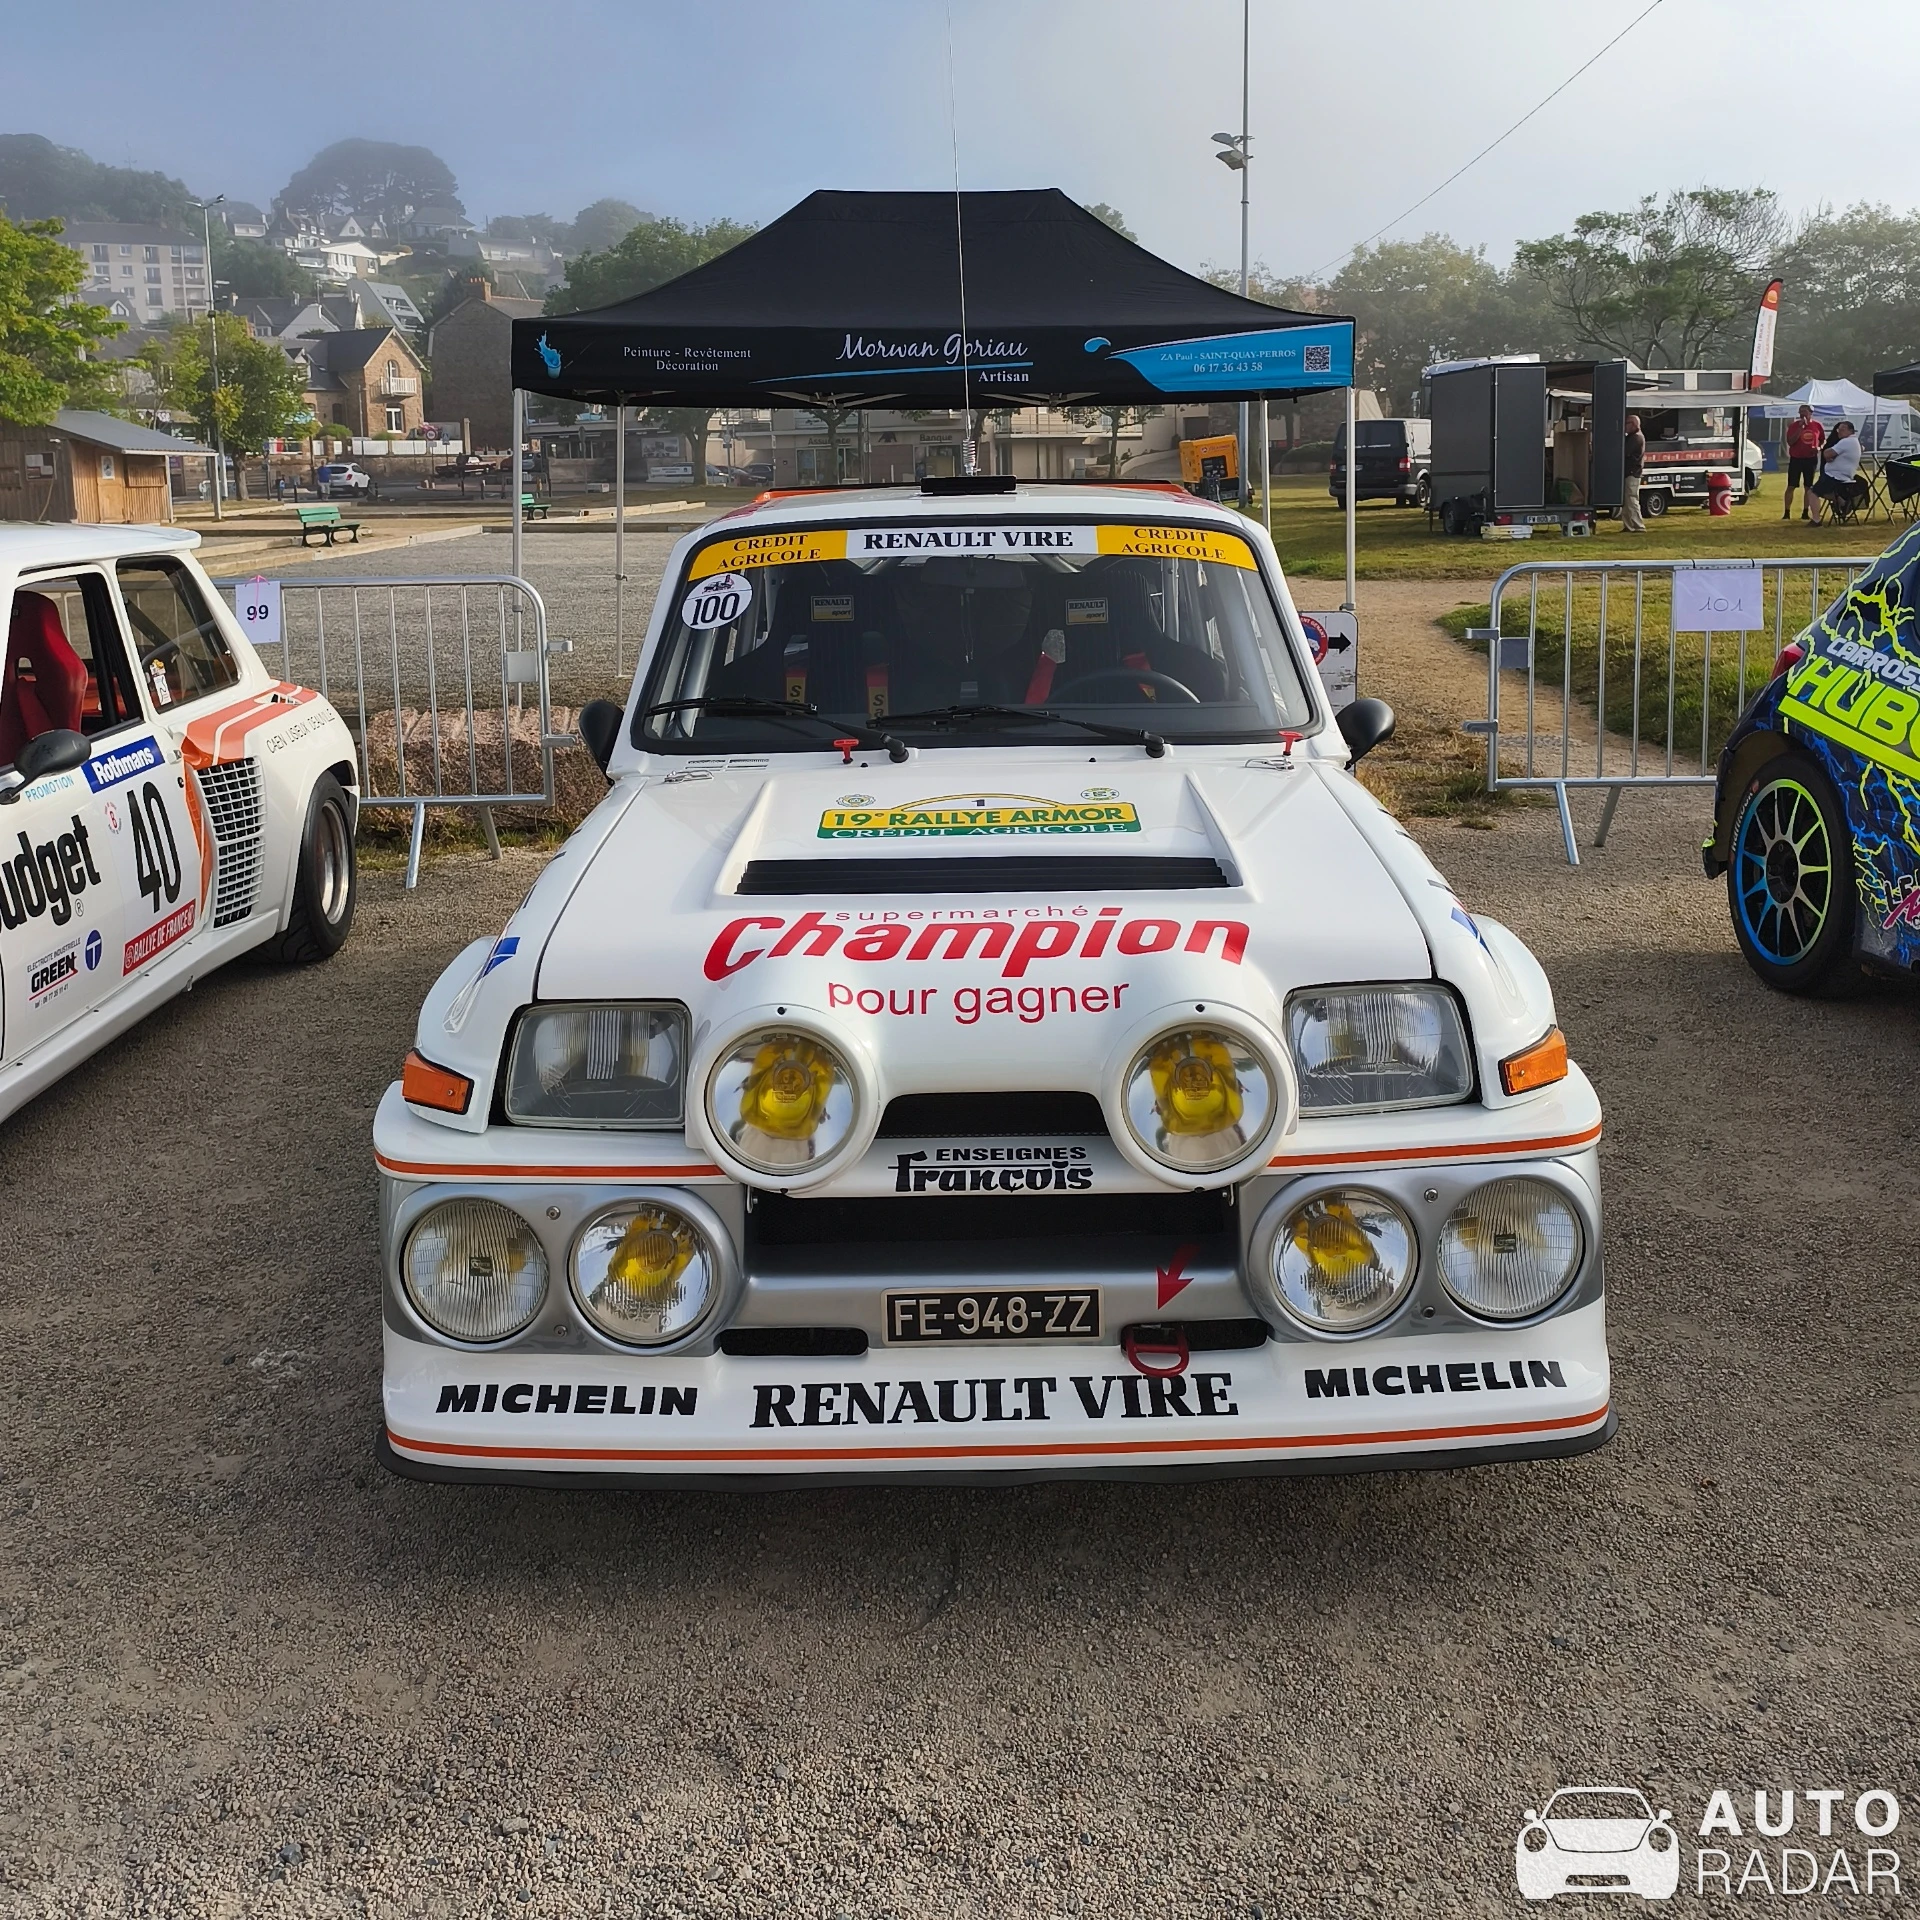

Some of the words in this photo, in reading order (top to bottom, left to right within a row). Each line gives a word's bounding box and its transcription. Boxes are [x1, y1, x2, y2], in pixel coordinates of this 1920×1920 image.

[623, 346, 671, 357] Peinture
[684, 347, 751, 358] Revêtement
[836, 334, 939, 360] Morwan
[943, 333, 1029, 365] Goriau
[1160, 353, 1173, 361] ZA
[1175, 352, 1193, 361] Paul
[1199, 349, 1297, 361] SAINT-QUAY-PERROS
[656, 360, 719, 371] Décoration
[1193, 363, 1206, 373] 06
[1208, 363, 1219, 373] 17
[1221, 363, 1234, 373] 36
[1236, 363, 1248, 372] 43
[1250, 362, 1263, 372] 58
[978, 371, 1030, 382] Artisan
[919, 433, 953, 442] Banque
[733, 534, 809, 552] CREDIT
[863, 531, 997, 549] RENAULT
[1001, 531, 1074, 547] VIRE
[1133, 528, 1209, 543] CREDIT
[717, 549, 821, 570] AGRICOLE
[1121, 543, 1227, 560] AGRICOLE
[690, 592, 740, 627] 100
[814, 598, 851, 607] RENAULT
[1068, 600, 1105, 609] RENAULT
[1699, 596, 1743, 611] 101
[246, 604, 269, 621] 99
[91, 747, 154, 785] Rothmans
[25, 774, 75, 802] PROMOTION
[972, 798, 985, 807] 1
[889, 811, 1008, 826] RALLYE
[1009, 807, 1127, 822] ARMOR
[831, 827, 955, 838] CRÉDIT
[965, 823, 1129, 835] AGRICOLE
[126, 781, 182, 914] 40
[835, 905, 1089, 922] supermarché
[133, 932, 156, 964] RALLYE
[157, 925, 165, 948] DE
[165, 912, 188, 943] FRANCE
[704, 907, 1250, 981] Champion
[27, 951, 54, 973] ELECTRICITE
[53, 937, 81, 959] INDUSTRIELLE
[31, 952, 77, 993] GREEN
[829, 982, 938, 1016] pour
[953, 983, 1130, 1025] gagner
[936, 1146, 1087, 1161] ENSEIGNES
[894, 1295, 1092, 1336] FE-948-ZZ
[1304, 1361, 1568, 1399] MICHELIN
[436, 1383, 699, 1416] MICHELIN
[749, 1377, 1058, 1428] RENAULT
[1069, 1372, 1239, 1419] VIRE
